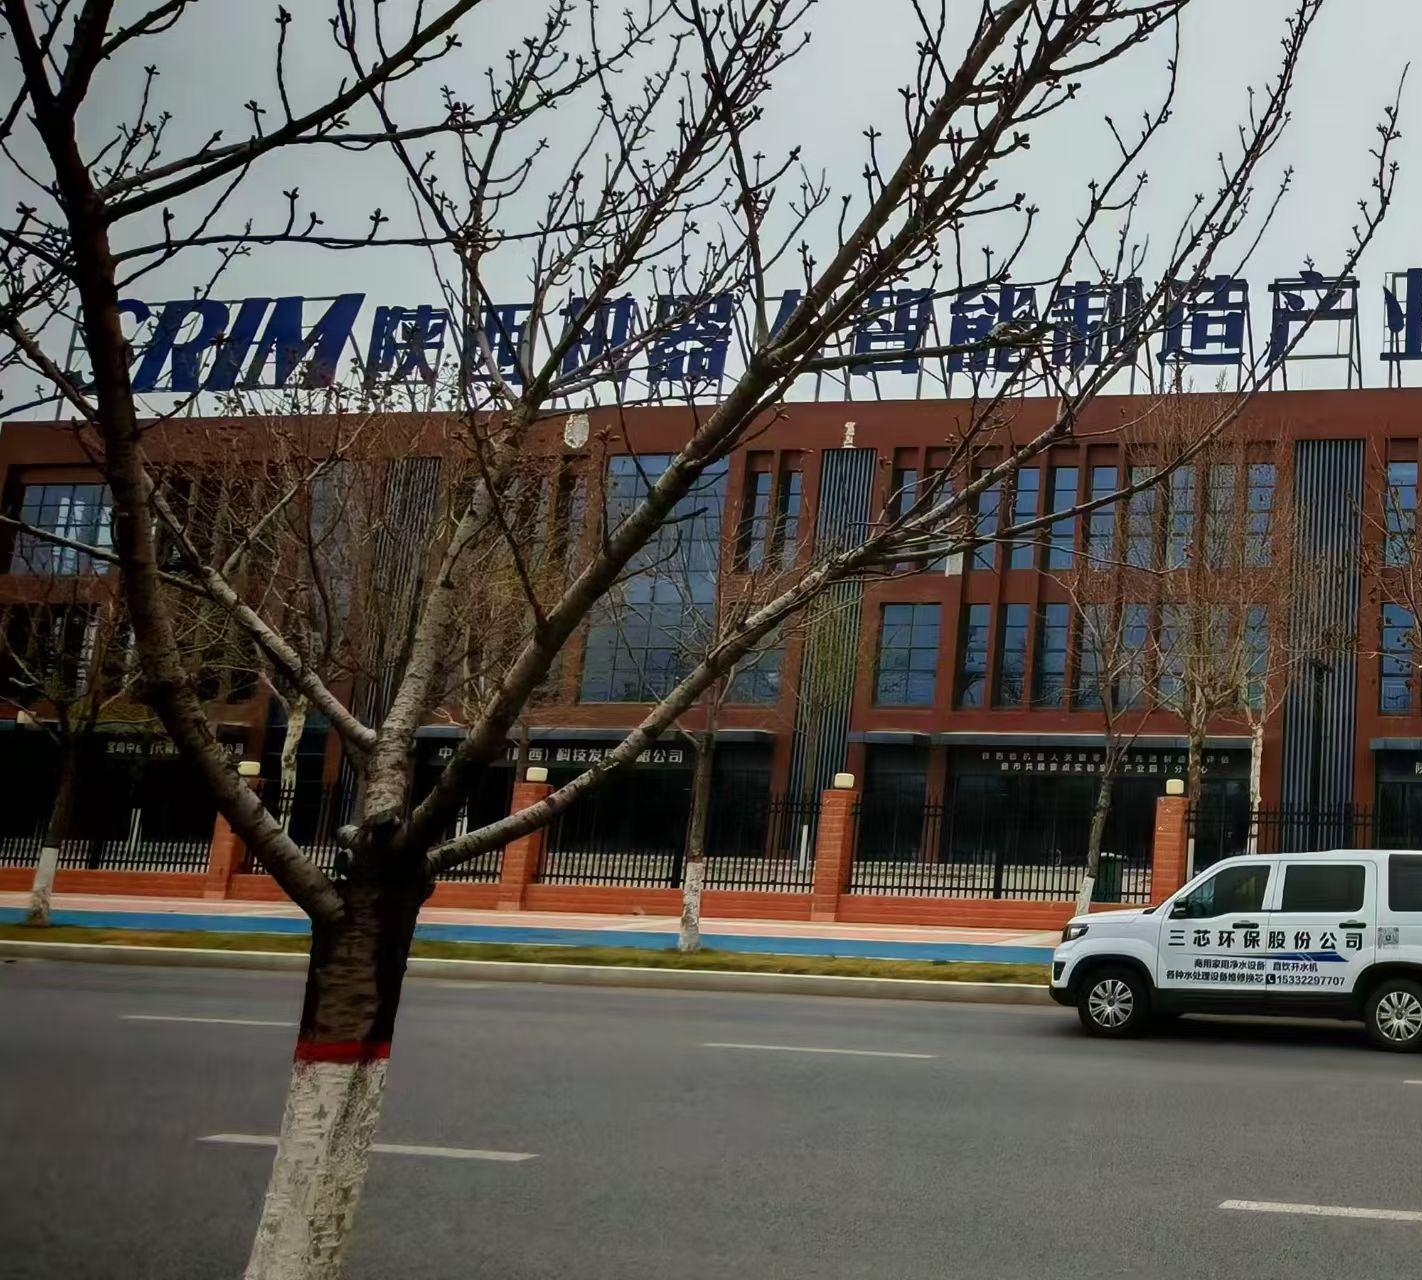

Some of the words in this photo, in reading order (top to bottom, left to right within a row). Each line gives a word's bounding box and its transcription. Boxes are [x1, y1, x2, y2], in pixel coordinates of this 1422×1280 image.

[1168, 929, 1363, 951] 三芯环保股份公司
[1194, 959, 1265, 971] 商用家用净水设备
[1273, 961, 1318, 973] 直饮开水机
[1166, 970, 1264, 984] 各种水处理设备维修换芯
[1277, 975, 1345, 986] 15332297707
